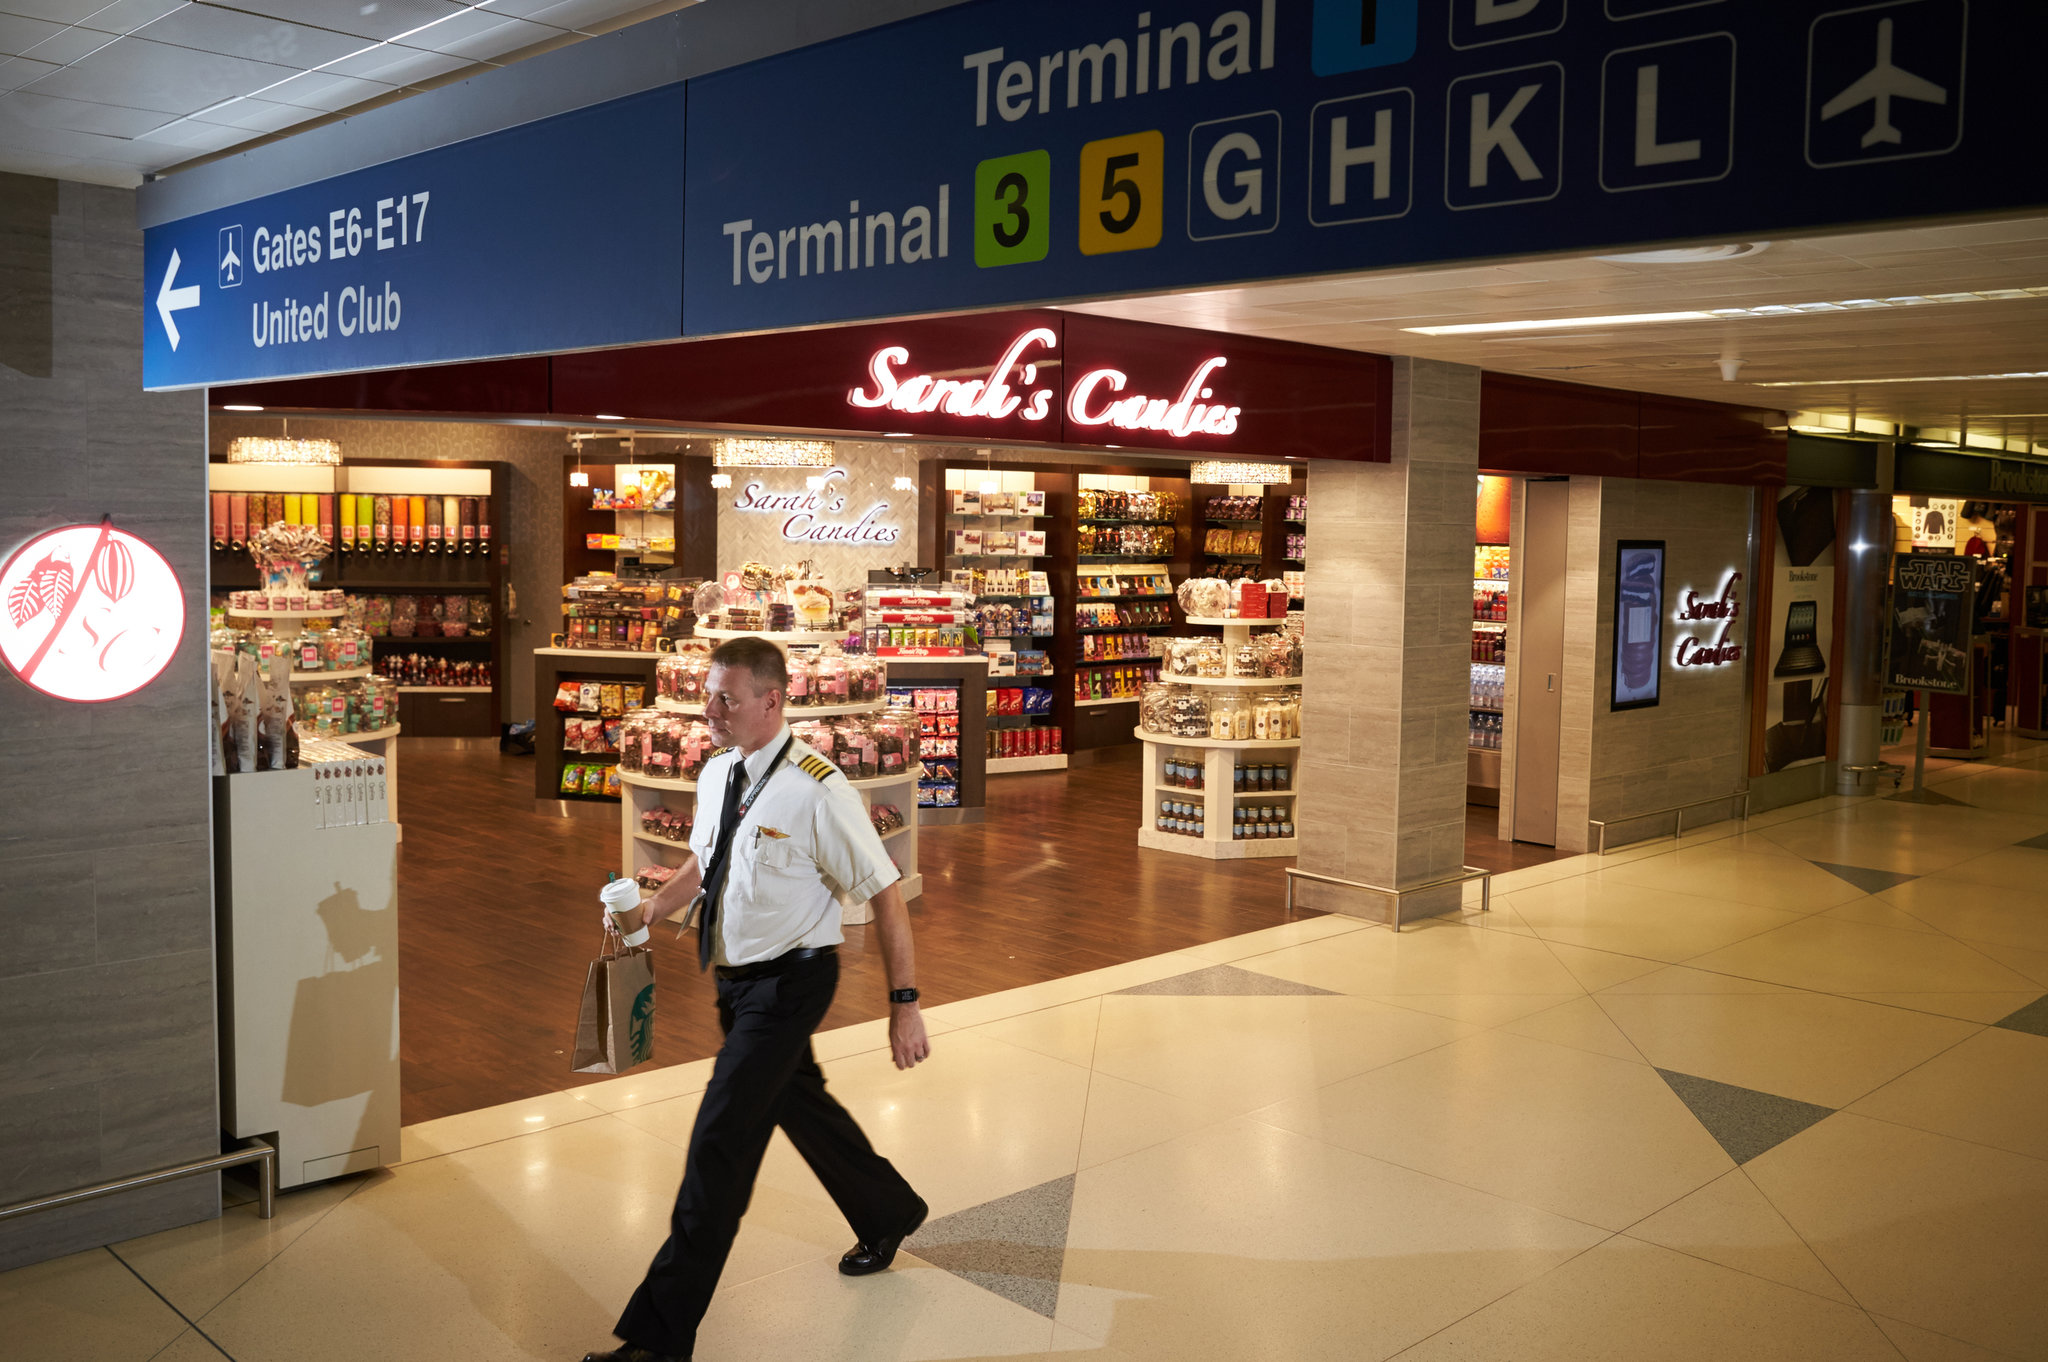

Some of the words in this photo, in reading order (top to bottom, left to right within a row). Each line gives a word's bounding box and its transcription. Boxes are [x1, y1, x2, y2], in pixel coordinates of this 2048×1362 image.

[964, 0, 1275, 126] Terminal
[723, 184, 949, 287] Terminal
[993, 172, 1030, 247] 3
[1099, 152, 1141, 235] 5
[1203, 132, 1263, 221] G
[1328, 108, 1392, 206] H
[1469, 83, 1543, 188] K
[1635, 65, 1701, 167] L
[252, 225, 321, 275] Gates
[329, 191, 430, 260] E6-E17
[252, 291, 328, 348] United
[337, 281, 401, 337] Club
[847, 327, 1057, 421] Sarah's
[1066, 357, 1242, 438] Candies
[734, 470, 845, 511] Sarah's
[783, 504, 899, 543] Candies
[1900, 559, 1970, 578] STAR
[1900, 574, 1970, 593] WARS
[1680, 572, 1742, 620] Sarah's
[1677, 620, 1742, 667] Candies
[745, 779, 767, 807] EXPRESS
